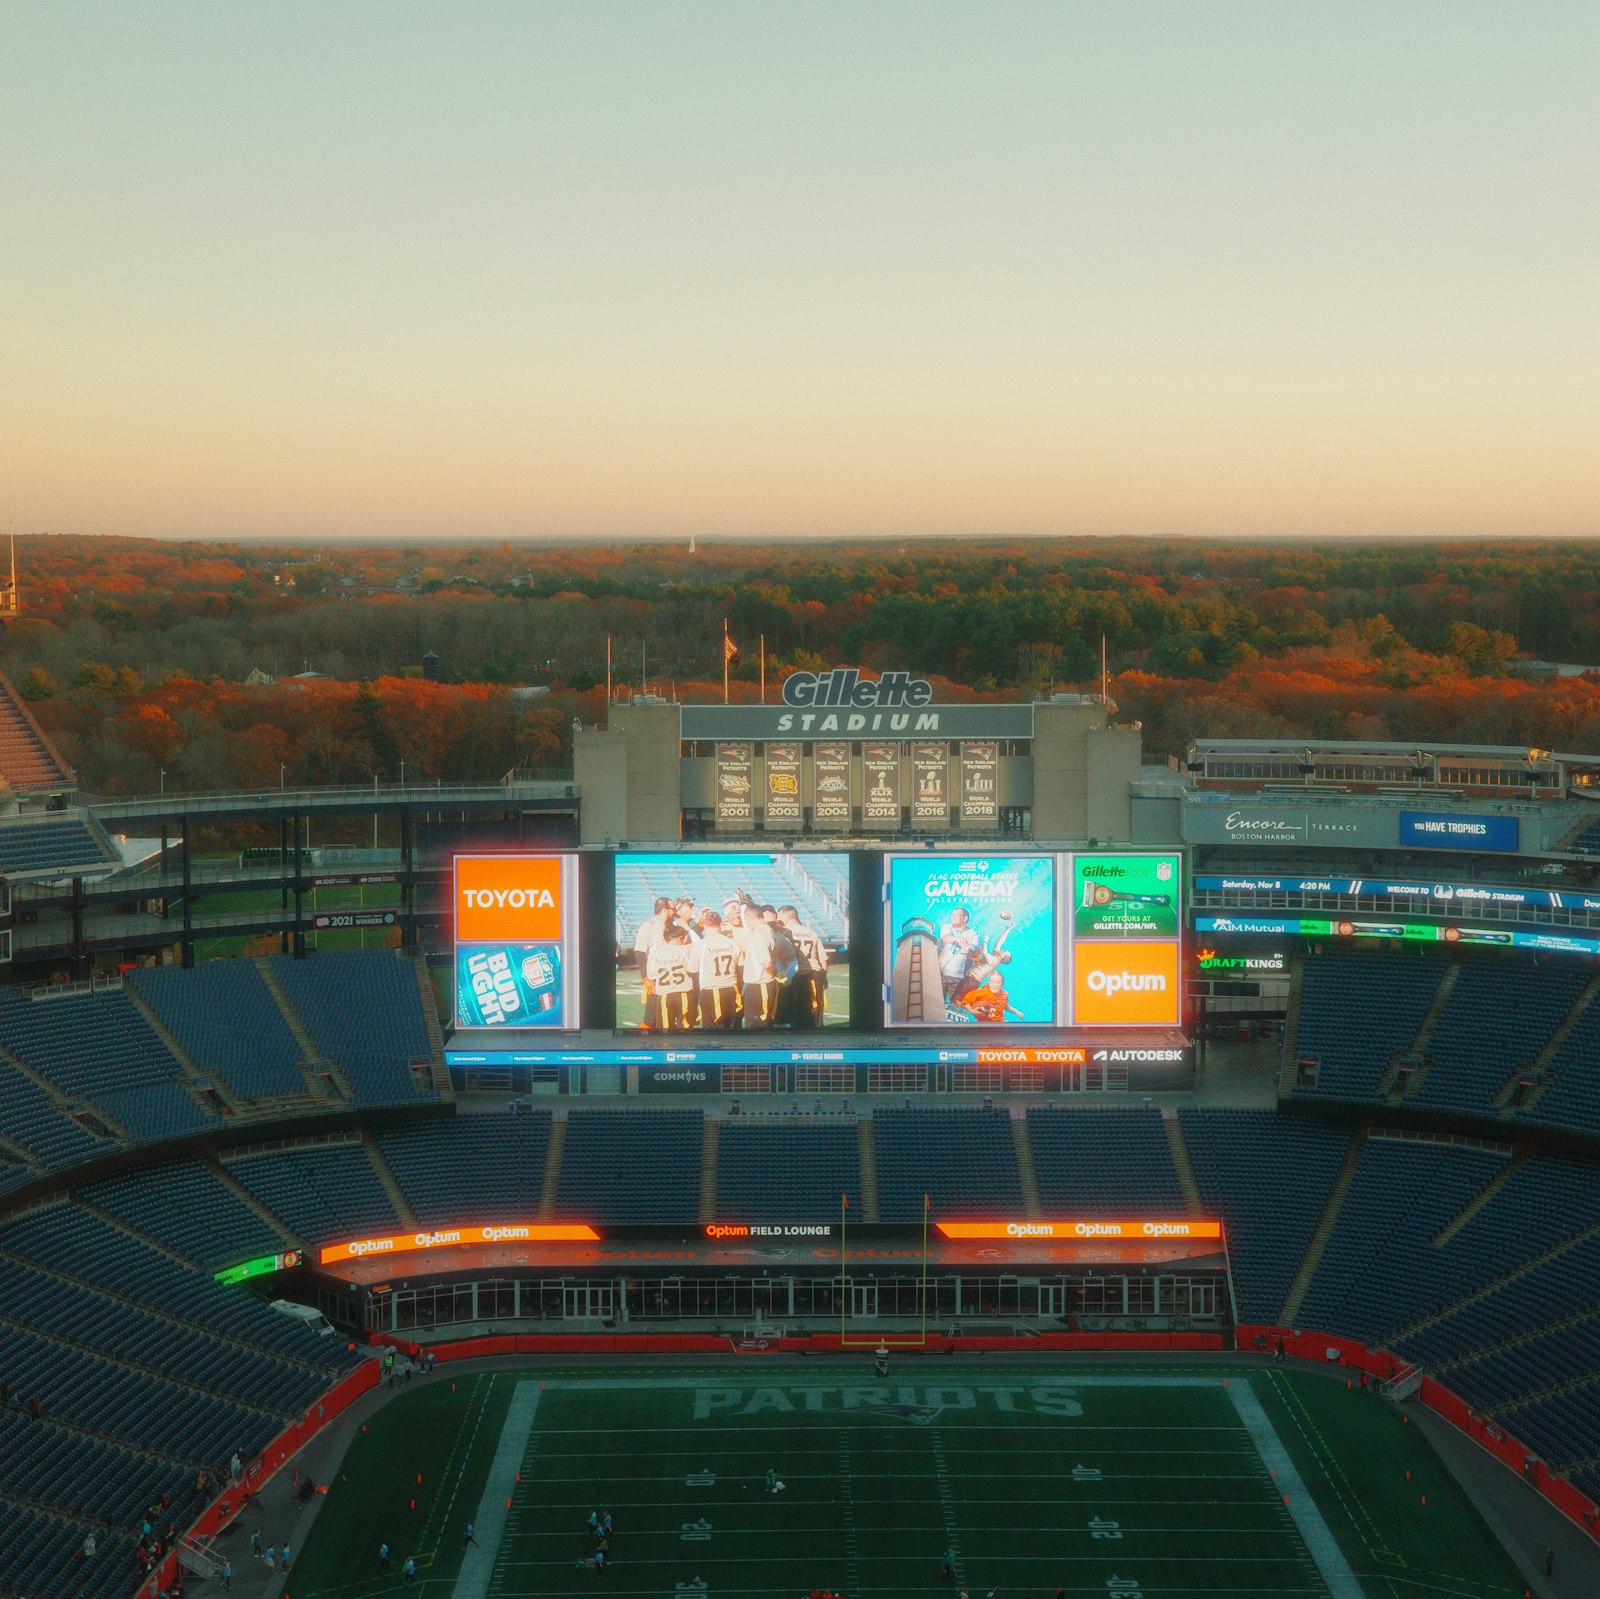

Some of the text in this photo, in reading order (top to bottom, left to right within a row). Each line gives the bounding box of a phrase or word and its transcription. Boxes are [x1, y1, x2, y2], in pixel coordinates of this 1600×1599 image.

[782, 669, 933, 708] Gillette
[777, 714, 939, 731] STADIUM
[721, 808, 749, 816] 2001
[768, 808, 799, 816] 2003
[817, 808, 848, 816] 2004
[868, 808, 896, 816] 2014
[917, 808, 944, 816] 2016
[966, 806, 994, 814] 2018
[1225, 811, 1302, 830] Encore
[1312, 824, 1358, 832] TERRACE
[1426, 822, 1446, 833] HAVE
[1448, 822, 1486, 835] TROPHIES
[924, 881, 1019, 897] GAMEDAY
[1222, 880, 1281, 890] Saturday, Nov 8
[1299, 882, 1331, 890] 4:20 PM
[463, 889, 555, 908] TOYOTA
[1387, 886, 1525, 902] WELCOME TO Gillette STADIUM
[331, 916, 353, 926] 2021
[1245, 924, 1285, 932] Mutual
[713, 955, 732, 976] 17
[1200, 958, 1284, 969] DRAFTKINGS
[658, 965, 685, 986] 25
[468, 953, 505, 1025] LIGHT
[487, 952, 520, 1013] BUD
[1087, 970, 1167, 997] Optum
[979, 1051, 1027, 1061] TOYOTA
[1035, 1051, 1083, 1061] TOYOTA
[1110, 1050, 1183, 1061] AUTODESK
[482, 1227, 529, 1241] Optum
[706, 1226, 831, 1238] Optum FIELD LOUNGE
[1007, 1224, 1053, 1237] Optum
[1075, 1223, 1122, 1237] Optum
[1143, 1223, 1190, 1236] Optum
[414, 1230, 460, 1247] Optum
[348, 1240, 393, 1256] Optum
[693, 1387, 1083, 1419] PATRIOTS
